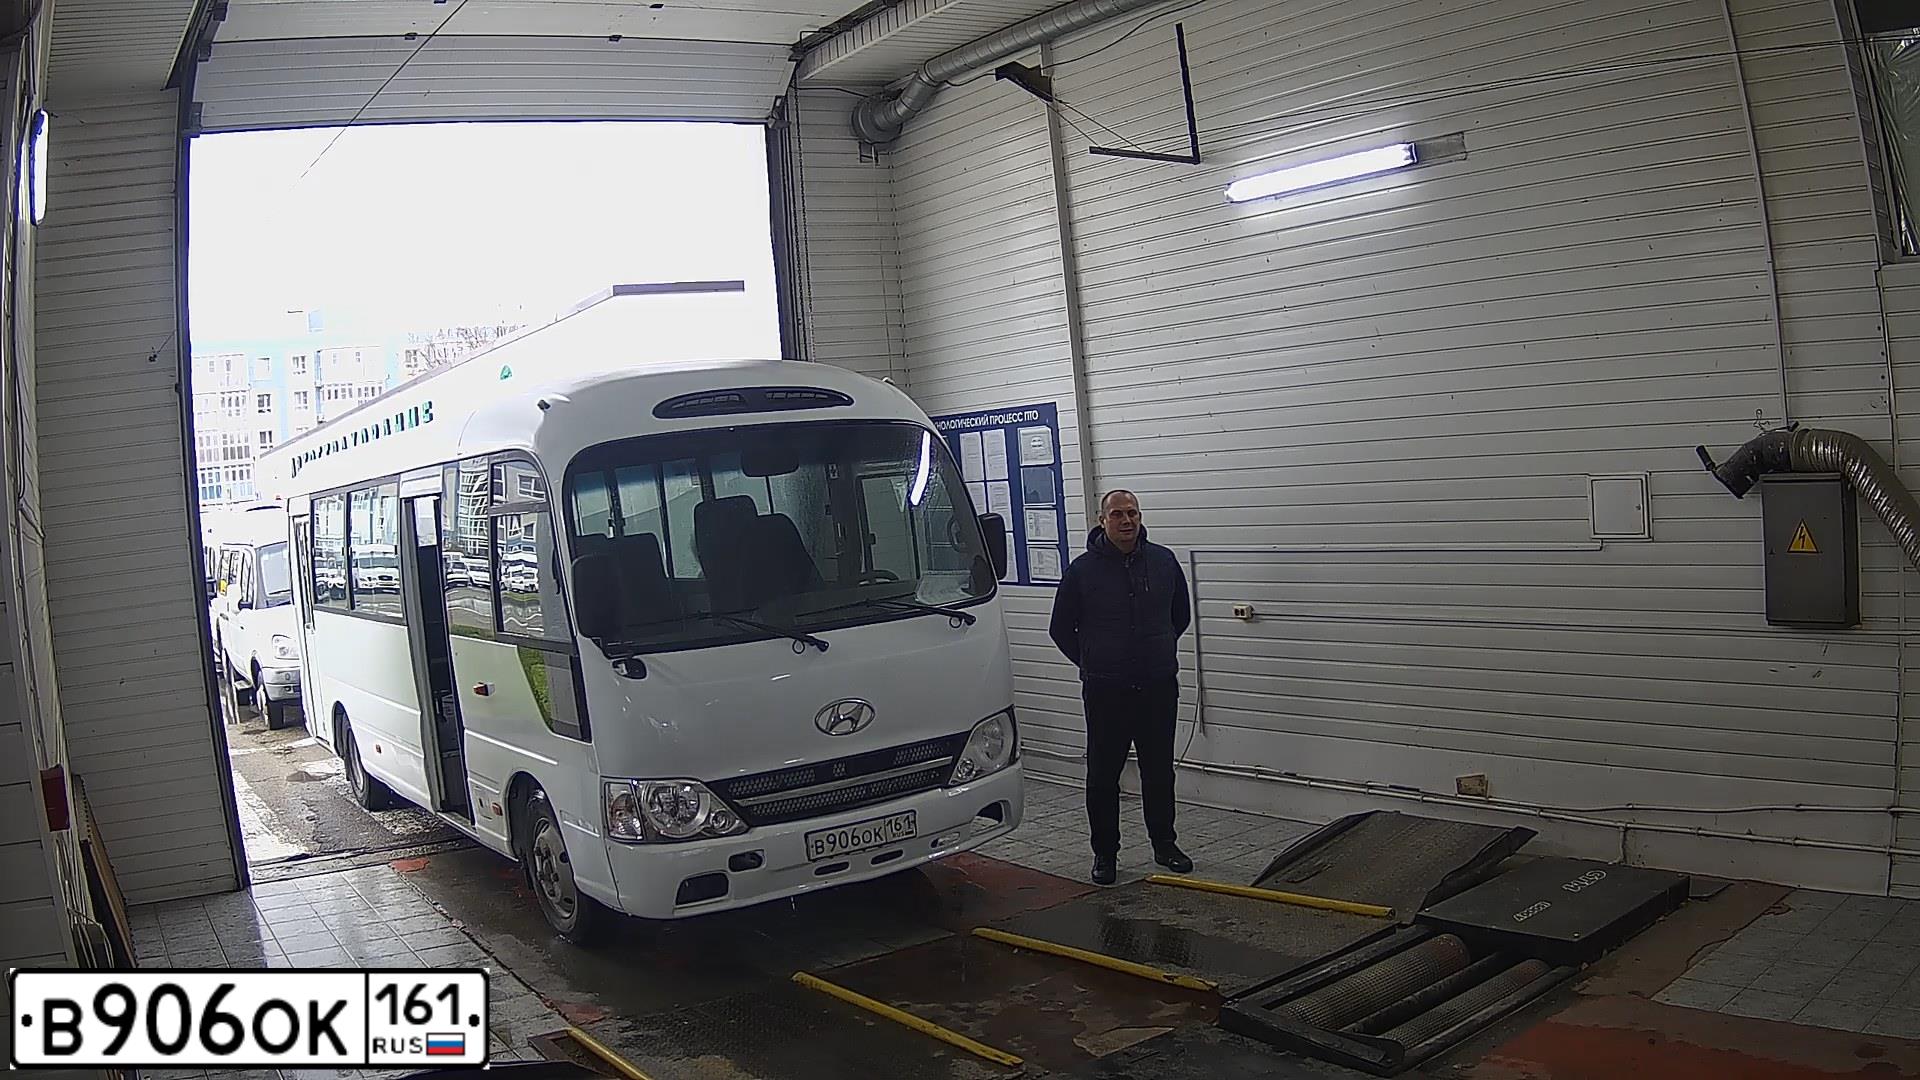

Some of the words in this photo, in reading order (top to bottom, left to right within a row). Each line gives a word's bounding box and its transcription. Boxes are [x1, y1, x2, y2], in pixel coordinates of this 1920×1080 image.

[935, 414, 988, 430] НОЛОГИЧЕСКИЙ
[989, 412, 1024, 425] ПРОЦЕСС
[1024, 410, 1038, 420] ПТО
[815, 827, 884, 854] В906ОК
[886, 815, 911, 833] 161
